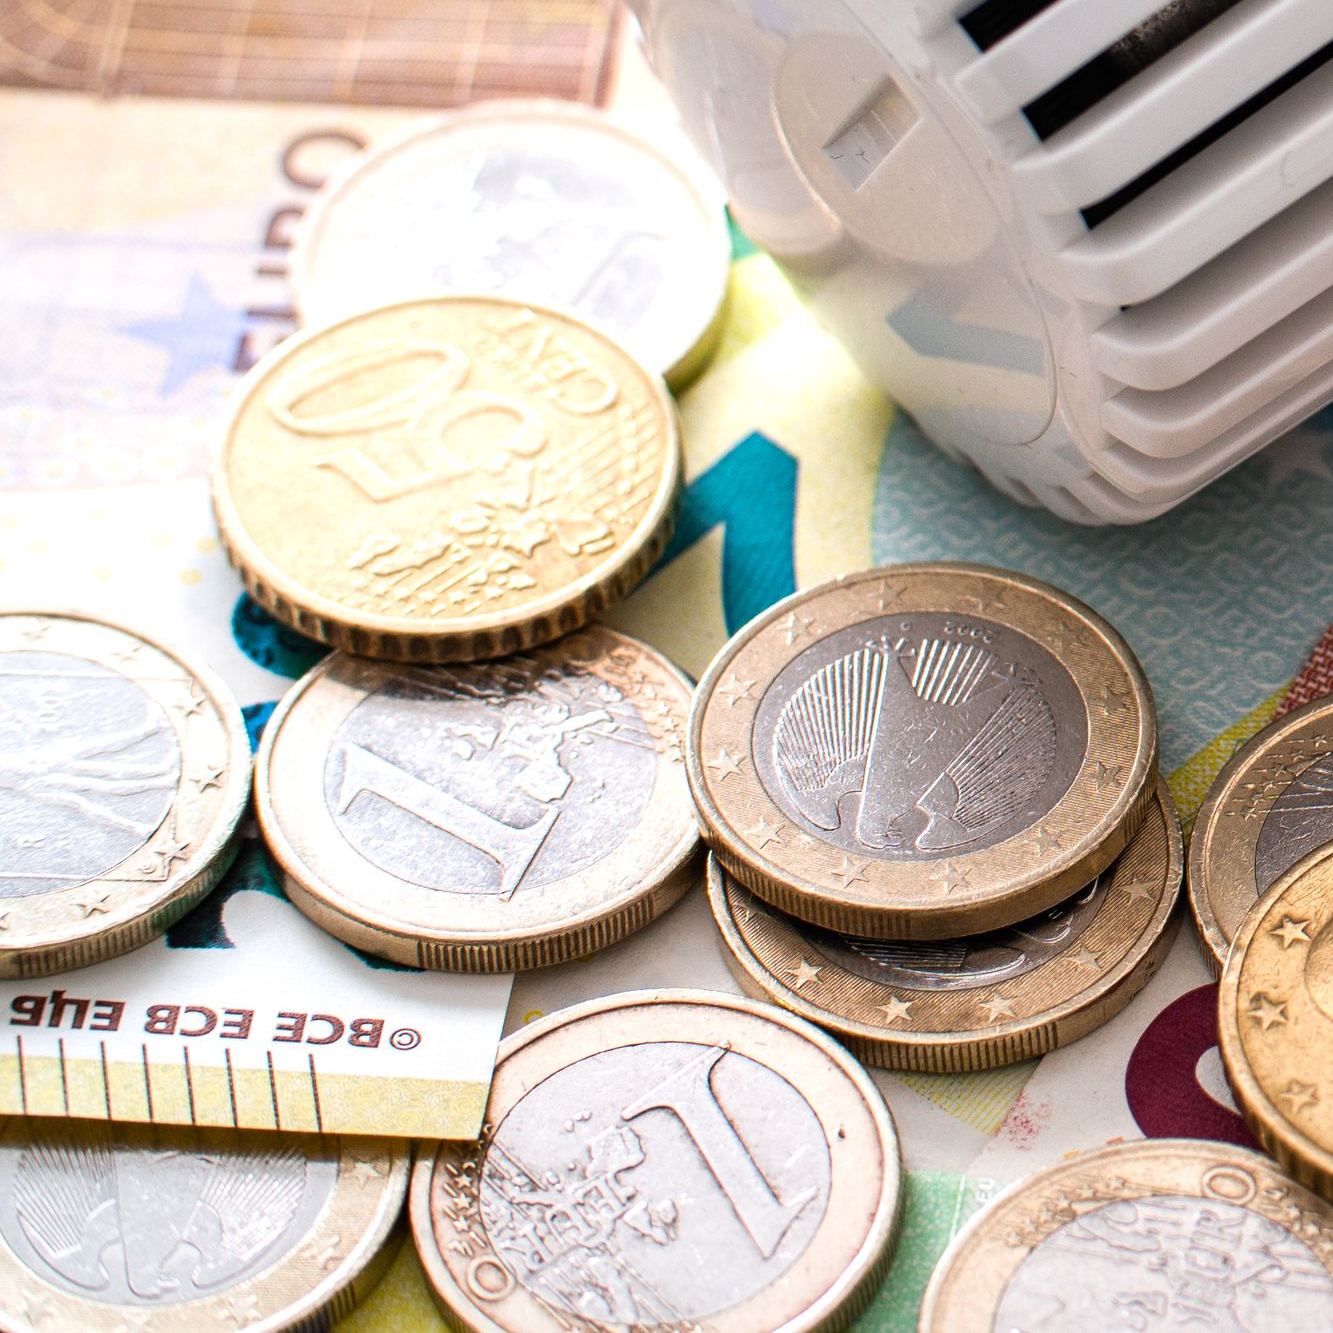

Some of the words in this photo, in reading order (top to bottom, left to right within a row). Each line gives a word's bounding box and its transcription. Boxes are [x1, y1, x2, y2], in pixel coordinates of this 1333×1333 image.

[339, 742, 561, 902] 1
[143, 1004, 255, 1040] ECB
[620, 1041, 818, 1262] 1
